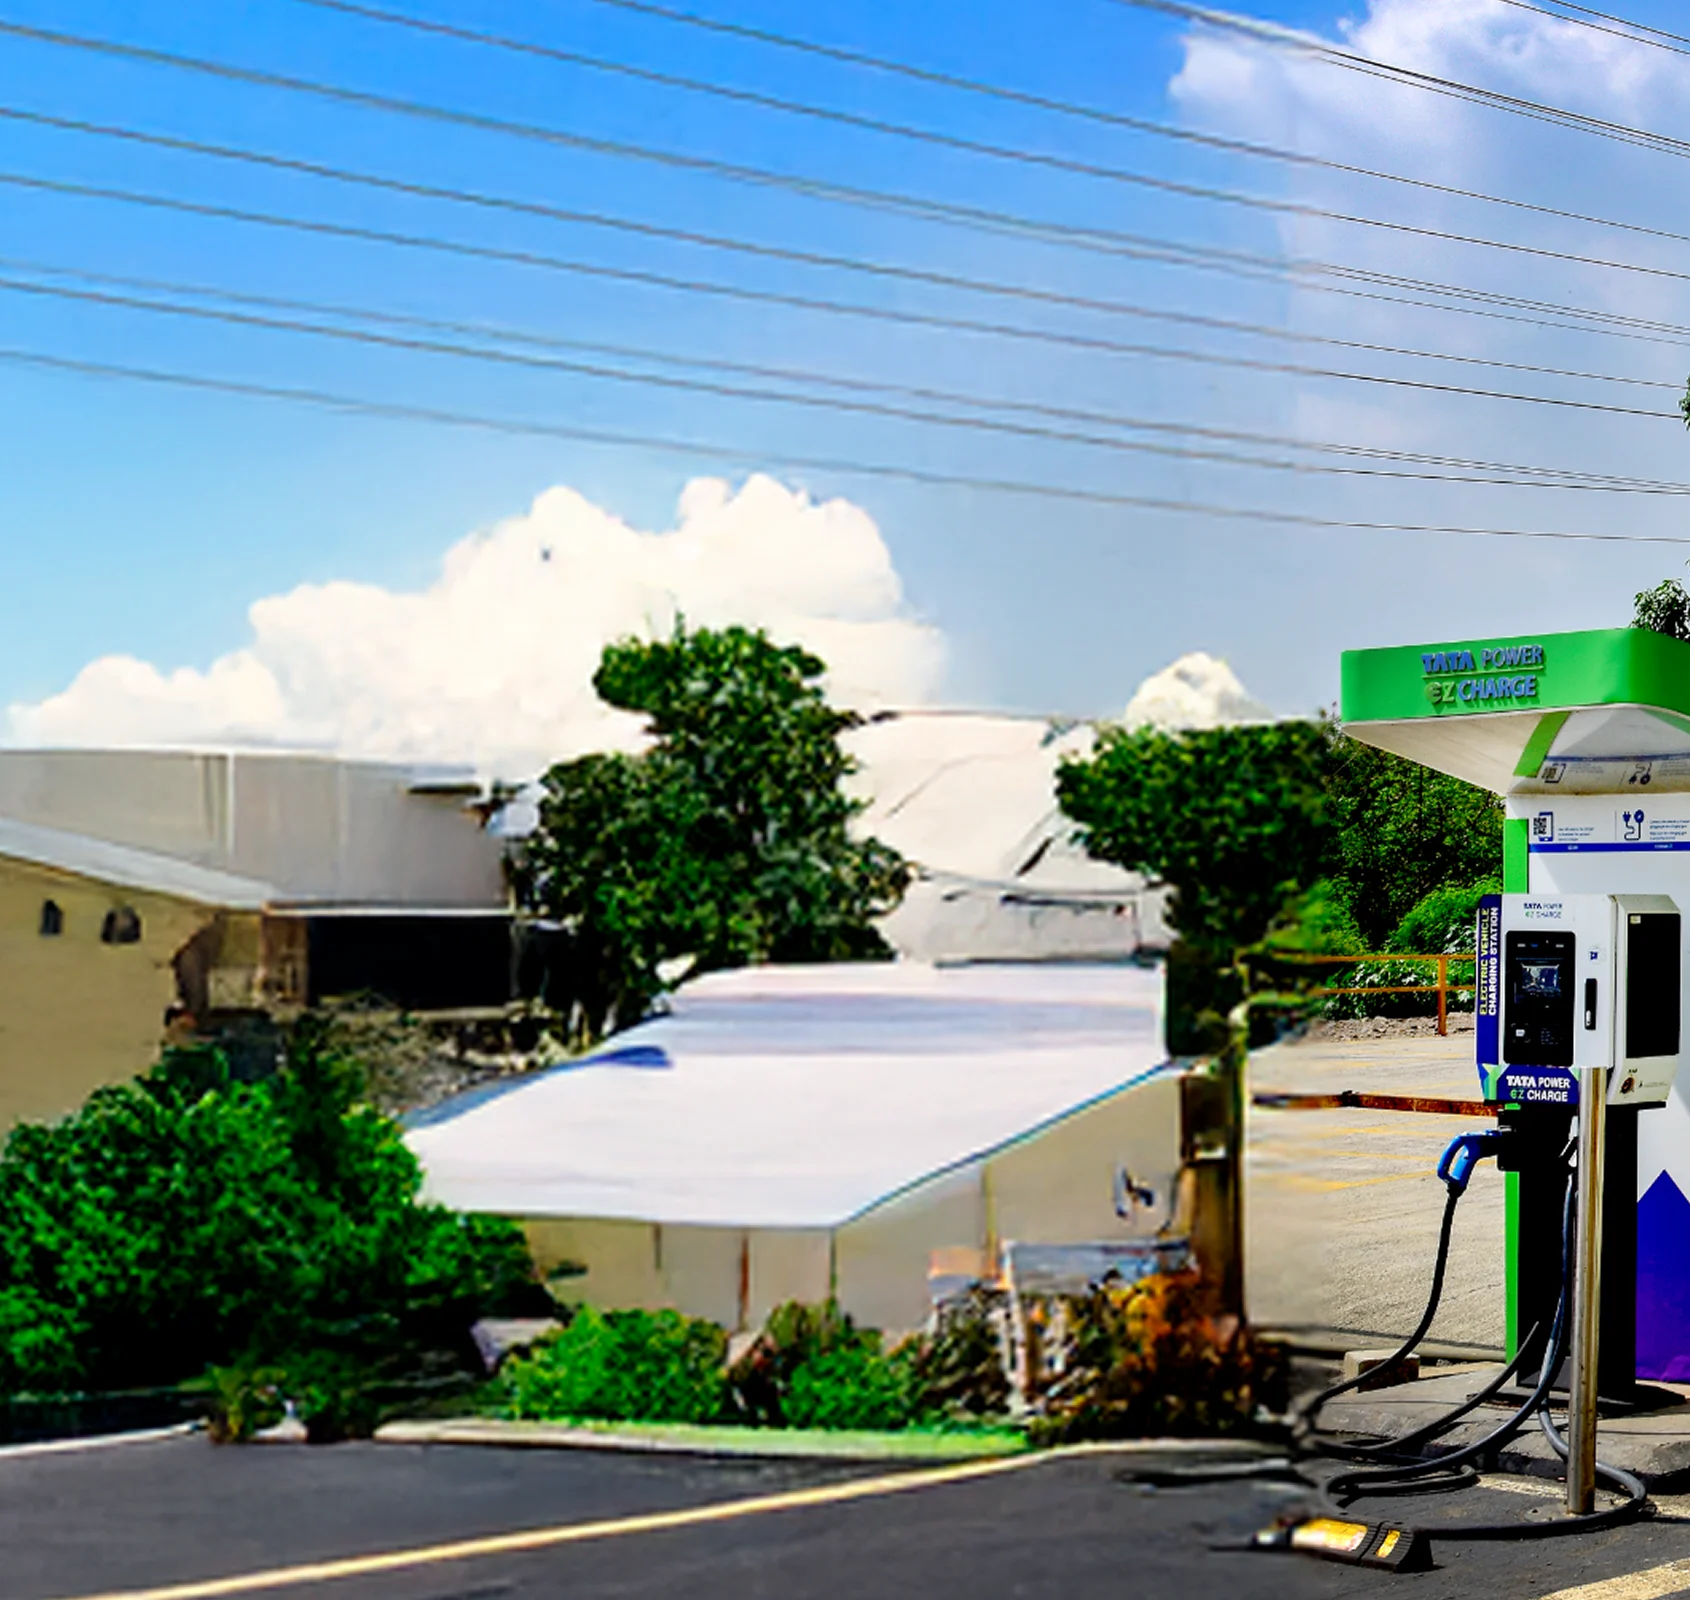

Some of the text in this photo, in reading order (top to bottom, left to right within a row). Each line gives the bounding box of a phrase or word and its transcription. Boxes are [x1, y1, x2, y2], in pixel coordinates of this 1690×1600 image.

[1421, 645, 1543, 672] TATA POWER
[1458, 675, 1537, 701] CHARGE
[1480, 908, 1489, 1016] ELECTRIC VEHICLE
[1488, 907, 1499, 1016] CHARGING STATION
[1506, 1075, 1571, 1089] TATA POWER
[1527, 1089, 1568, 1102] CHARGE
